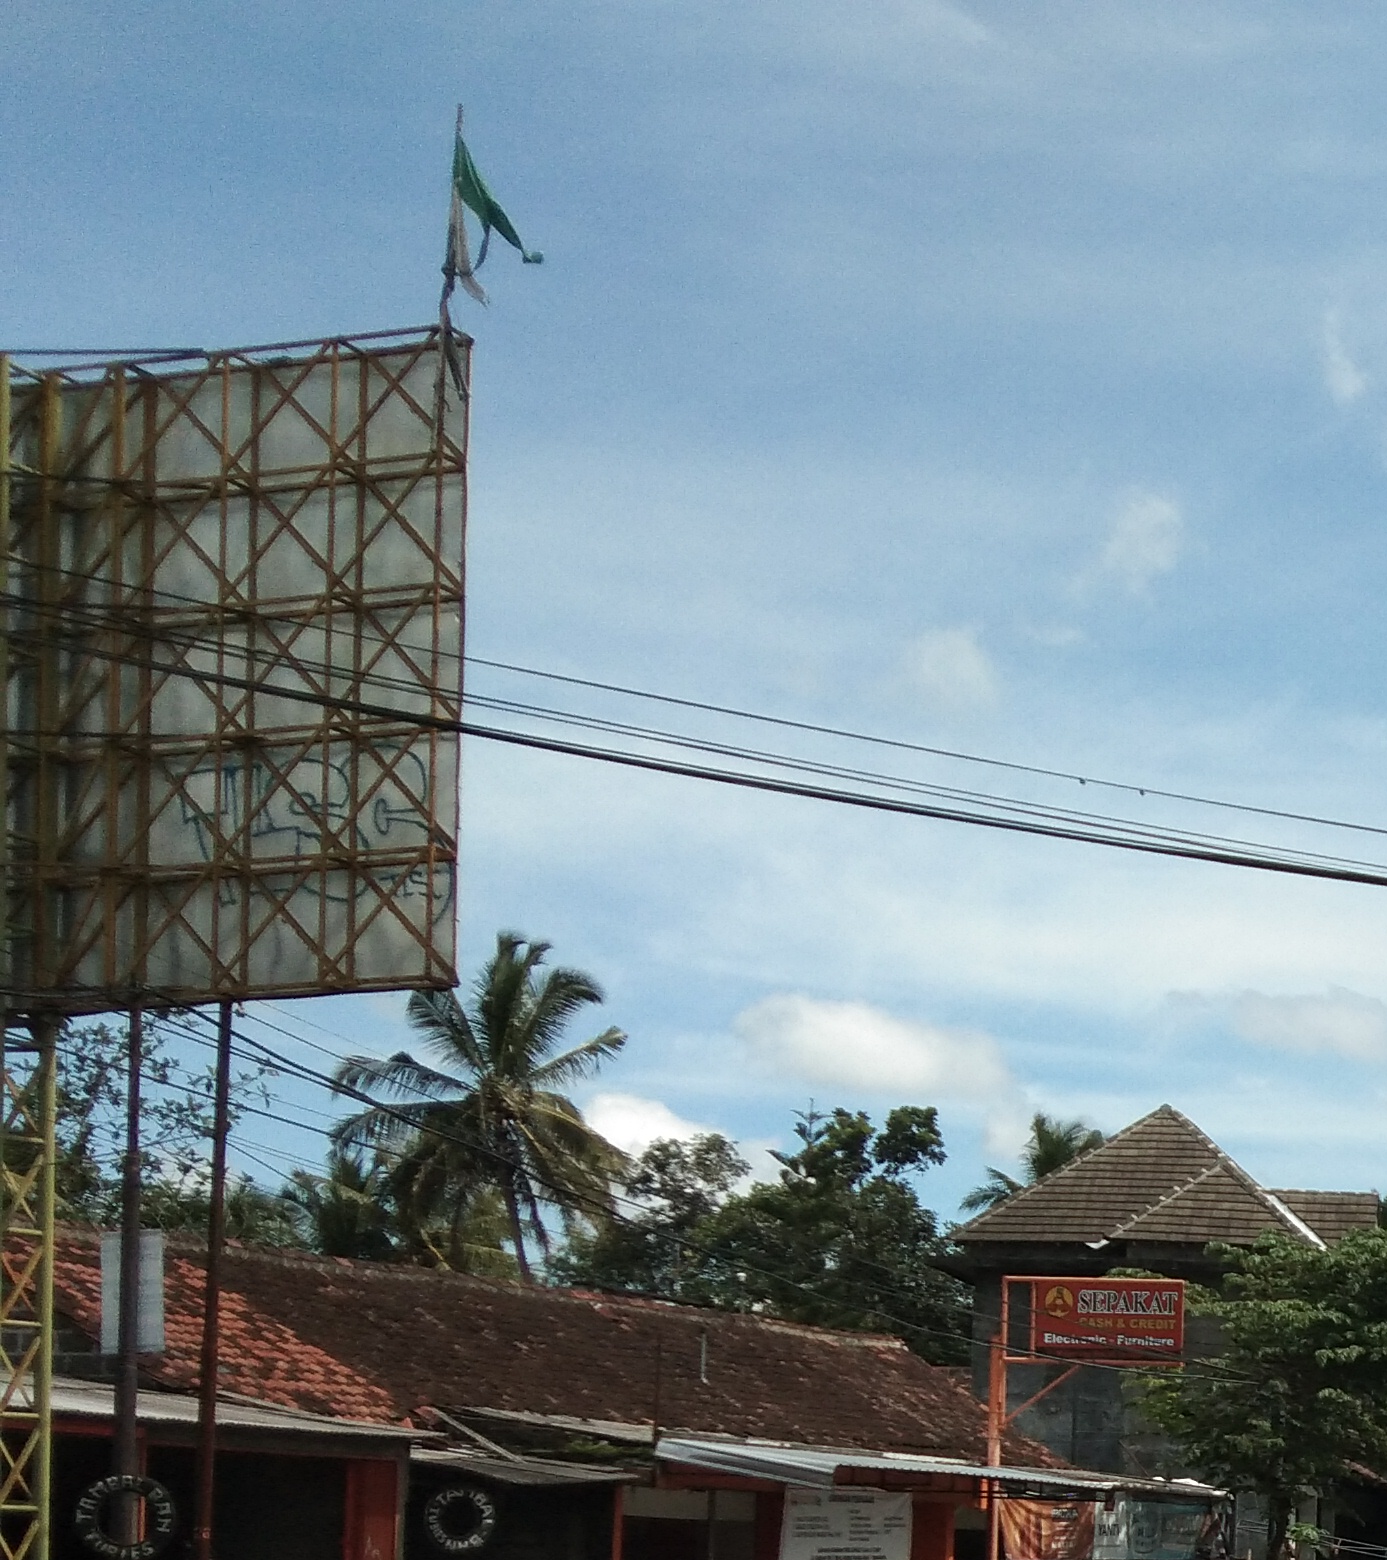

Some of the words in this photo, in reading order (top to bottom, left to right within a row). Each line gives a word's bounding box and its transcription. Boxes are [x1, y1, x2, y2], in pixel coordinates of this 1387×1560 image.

[1077, 1290, 1178, 1316] SEPAKAT
[1079, 1317, 1114, 1329] CASH
[1117, 1318, 1126, 1329] &
[1129, 1319, 1177, 1330] CREDIT
[1043, 1332, 1107, 1345] Electronic
[1117, 1335, 1174, 1347] Furniture
